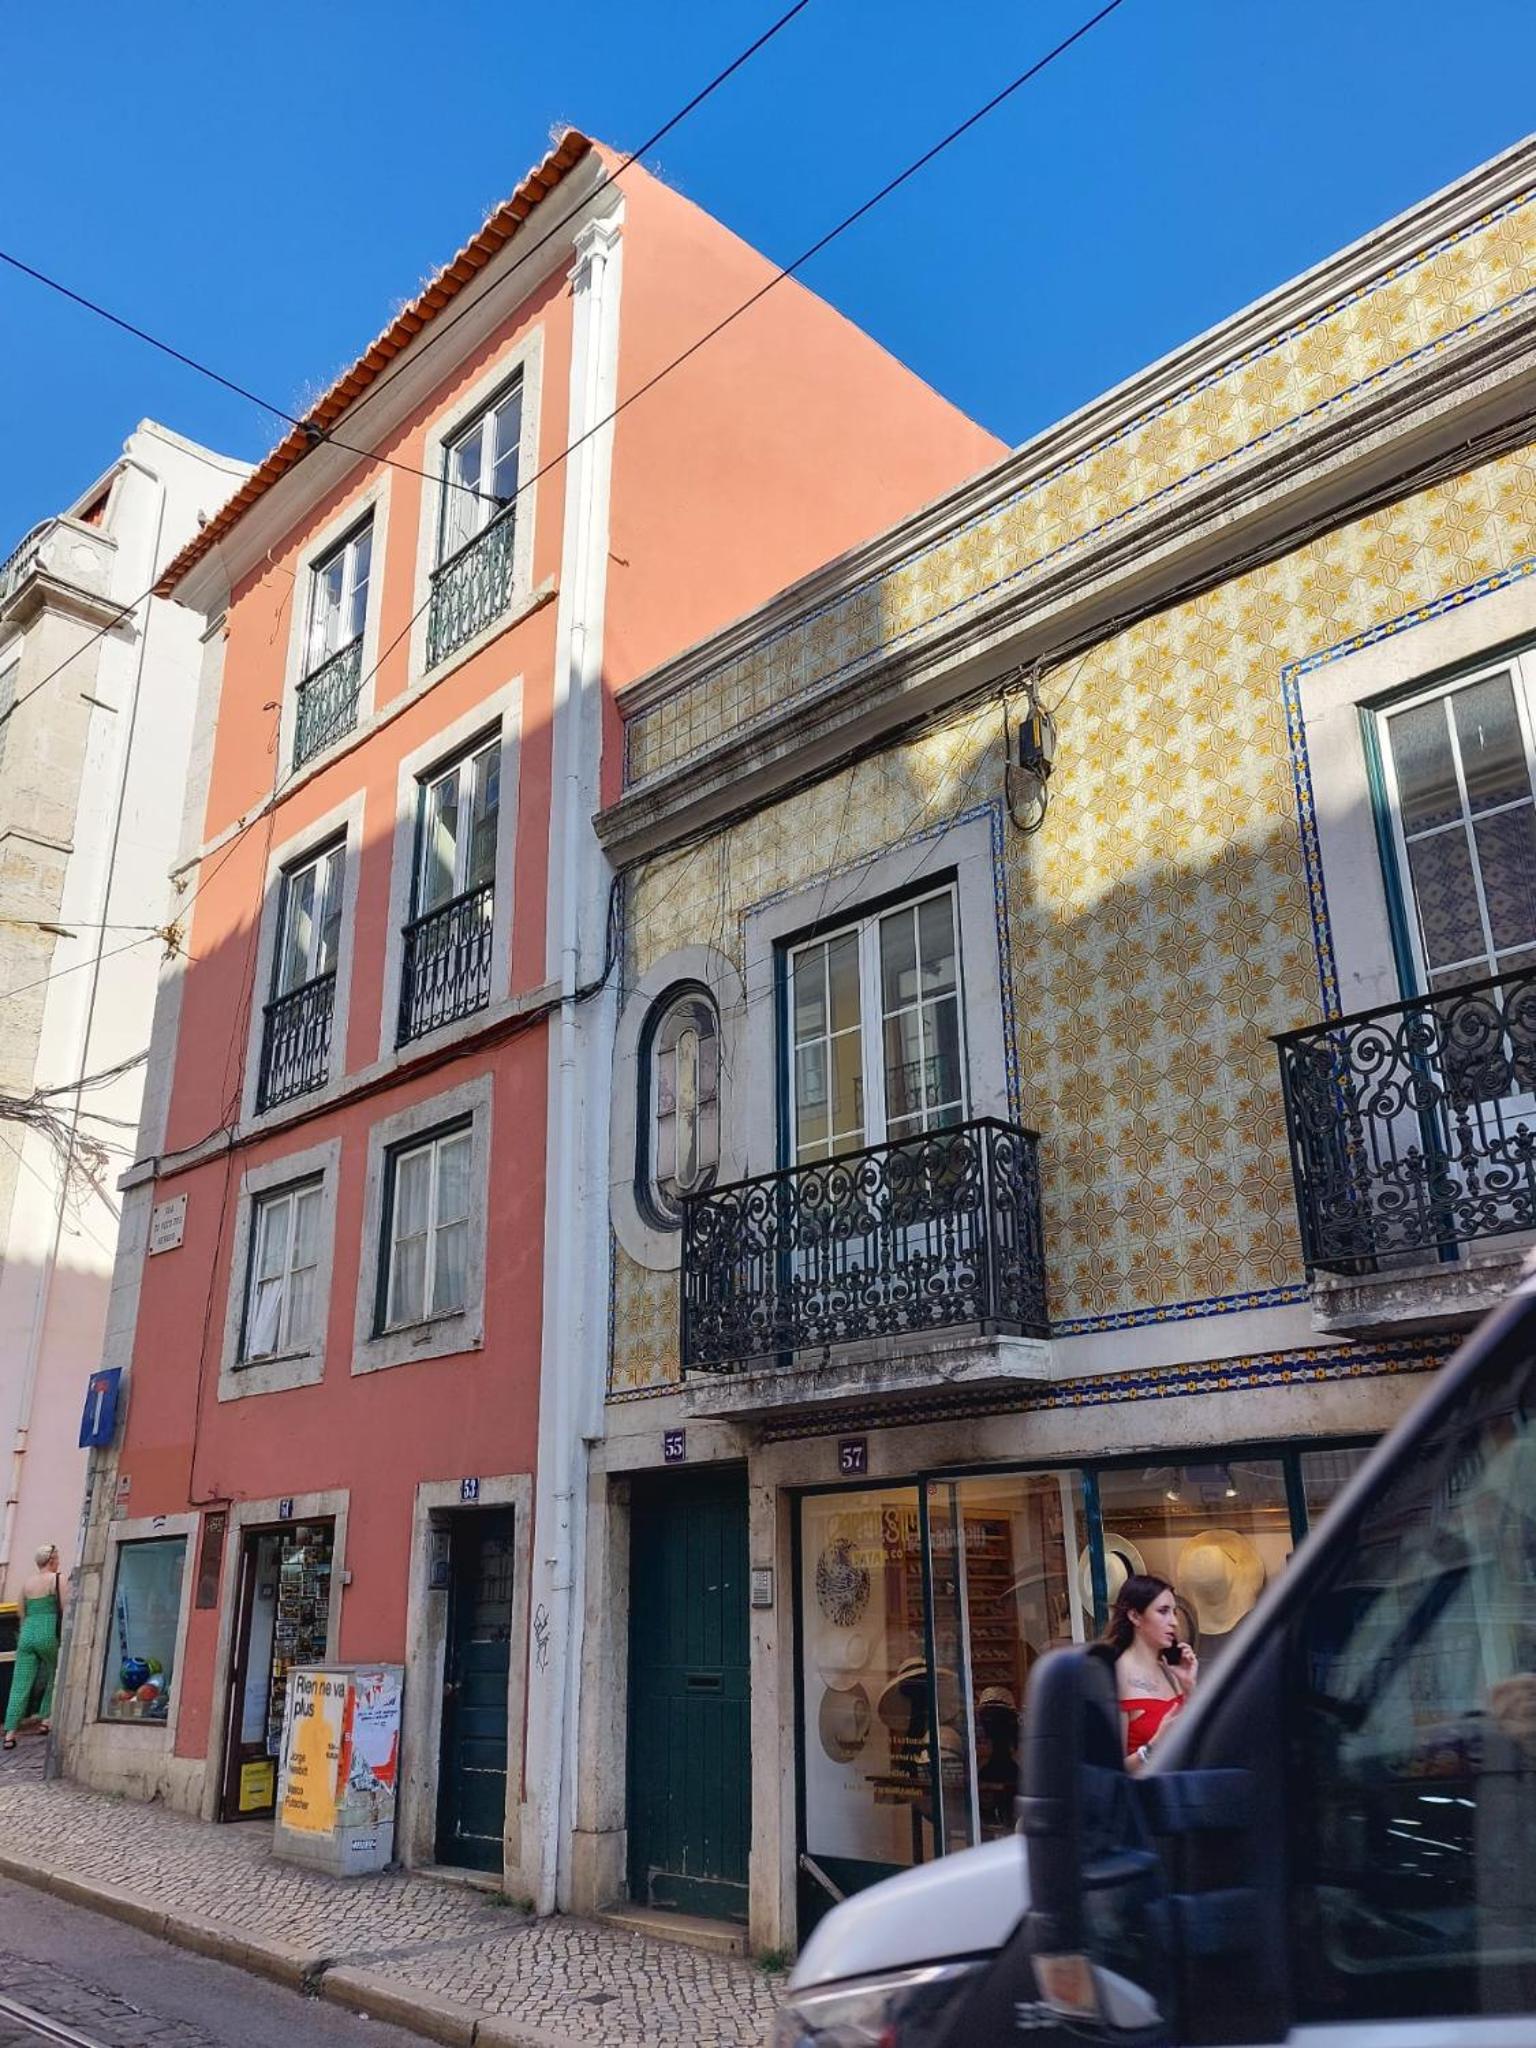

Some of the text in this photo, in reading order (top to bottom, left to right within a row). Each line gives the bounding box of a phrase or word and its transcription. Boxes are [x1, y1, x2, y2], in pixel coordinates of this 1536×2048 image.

[665, 1436, 683, 1457] 55
[842, 1447, 863, 1468] 57
[463, 1479, 476, 1499] 53
[296, 1674, 345, 1698] Rien ne va
[293, 1698, 315, 1720] plus
